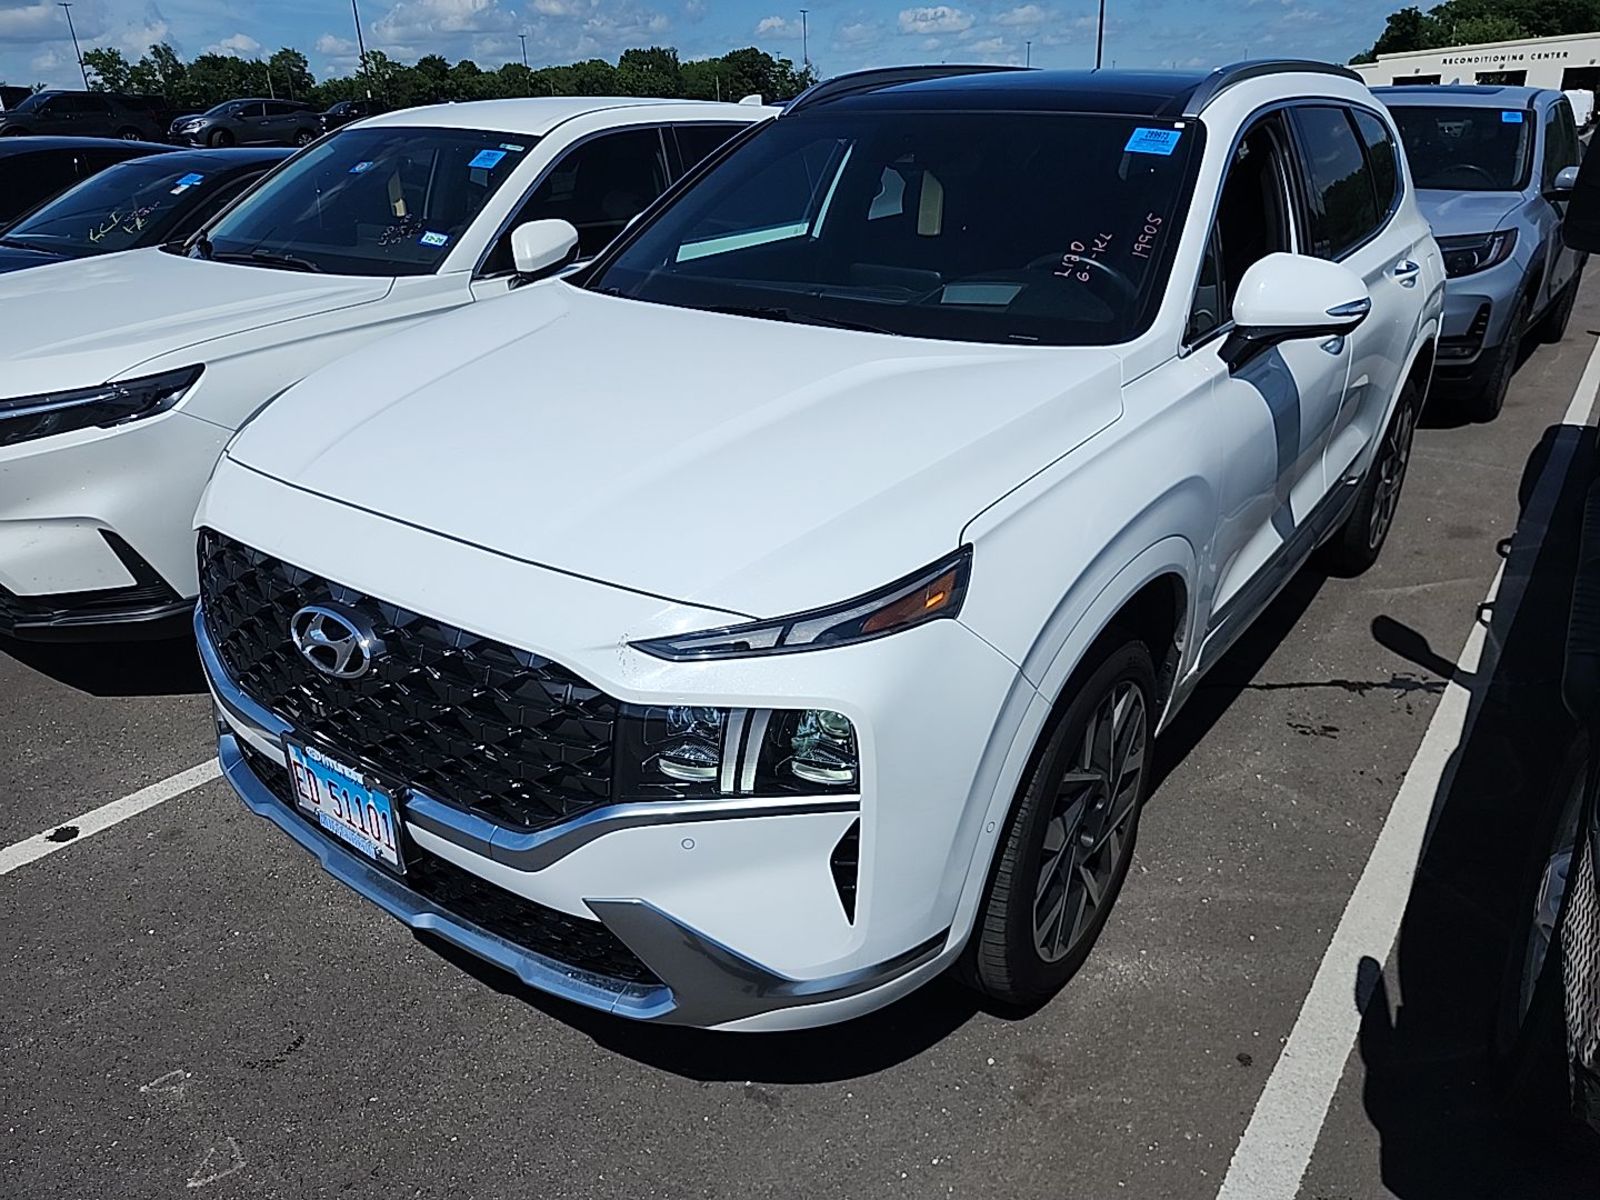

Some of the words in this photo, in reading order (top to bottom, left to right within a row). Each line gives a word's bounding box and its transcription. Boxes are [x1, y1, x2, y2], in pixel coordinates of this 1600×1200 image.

[1442, 54, 1524, 64] RECONDITIONING
[293, 760, 321, 805] ED
[327, 779, 395, 852] 51101
